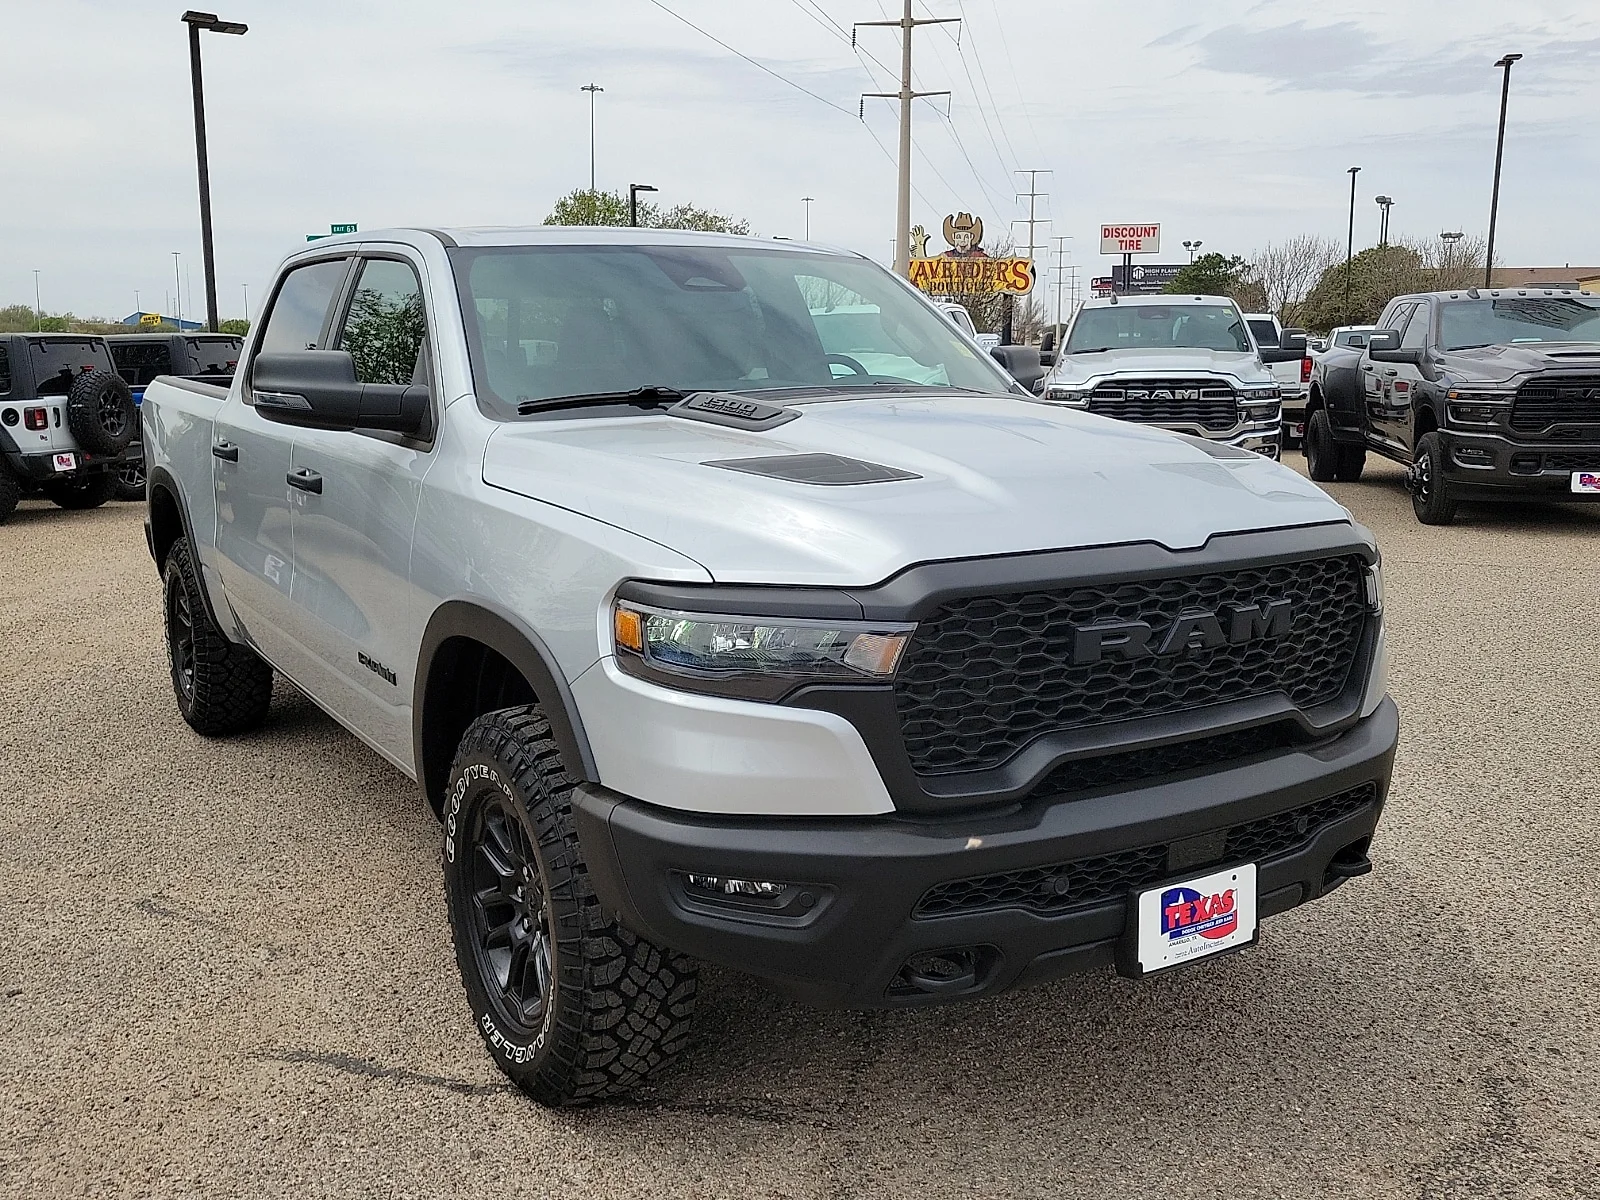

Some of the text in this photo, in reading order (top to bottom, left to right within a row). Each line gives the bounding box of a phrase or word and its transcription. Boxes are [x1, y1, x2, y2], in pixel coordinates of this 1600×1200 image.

[346, 225, 356, 233] 63
[1103, 226, 1158, 238] DISCOUNT
[1118, 239, 1142, 251] TIRE
[1126, 389, 1198, 400] RAM
[704, 396, 758, 413] 1500
[1073, 598, 1292, 664] RAM
[1165, 888, 1235, 930] TEXAS
